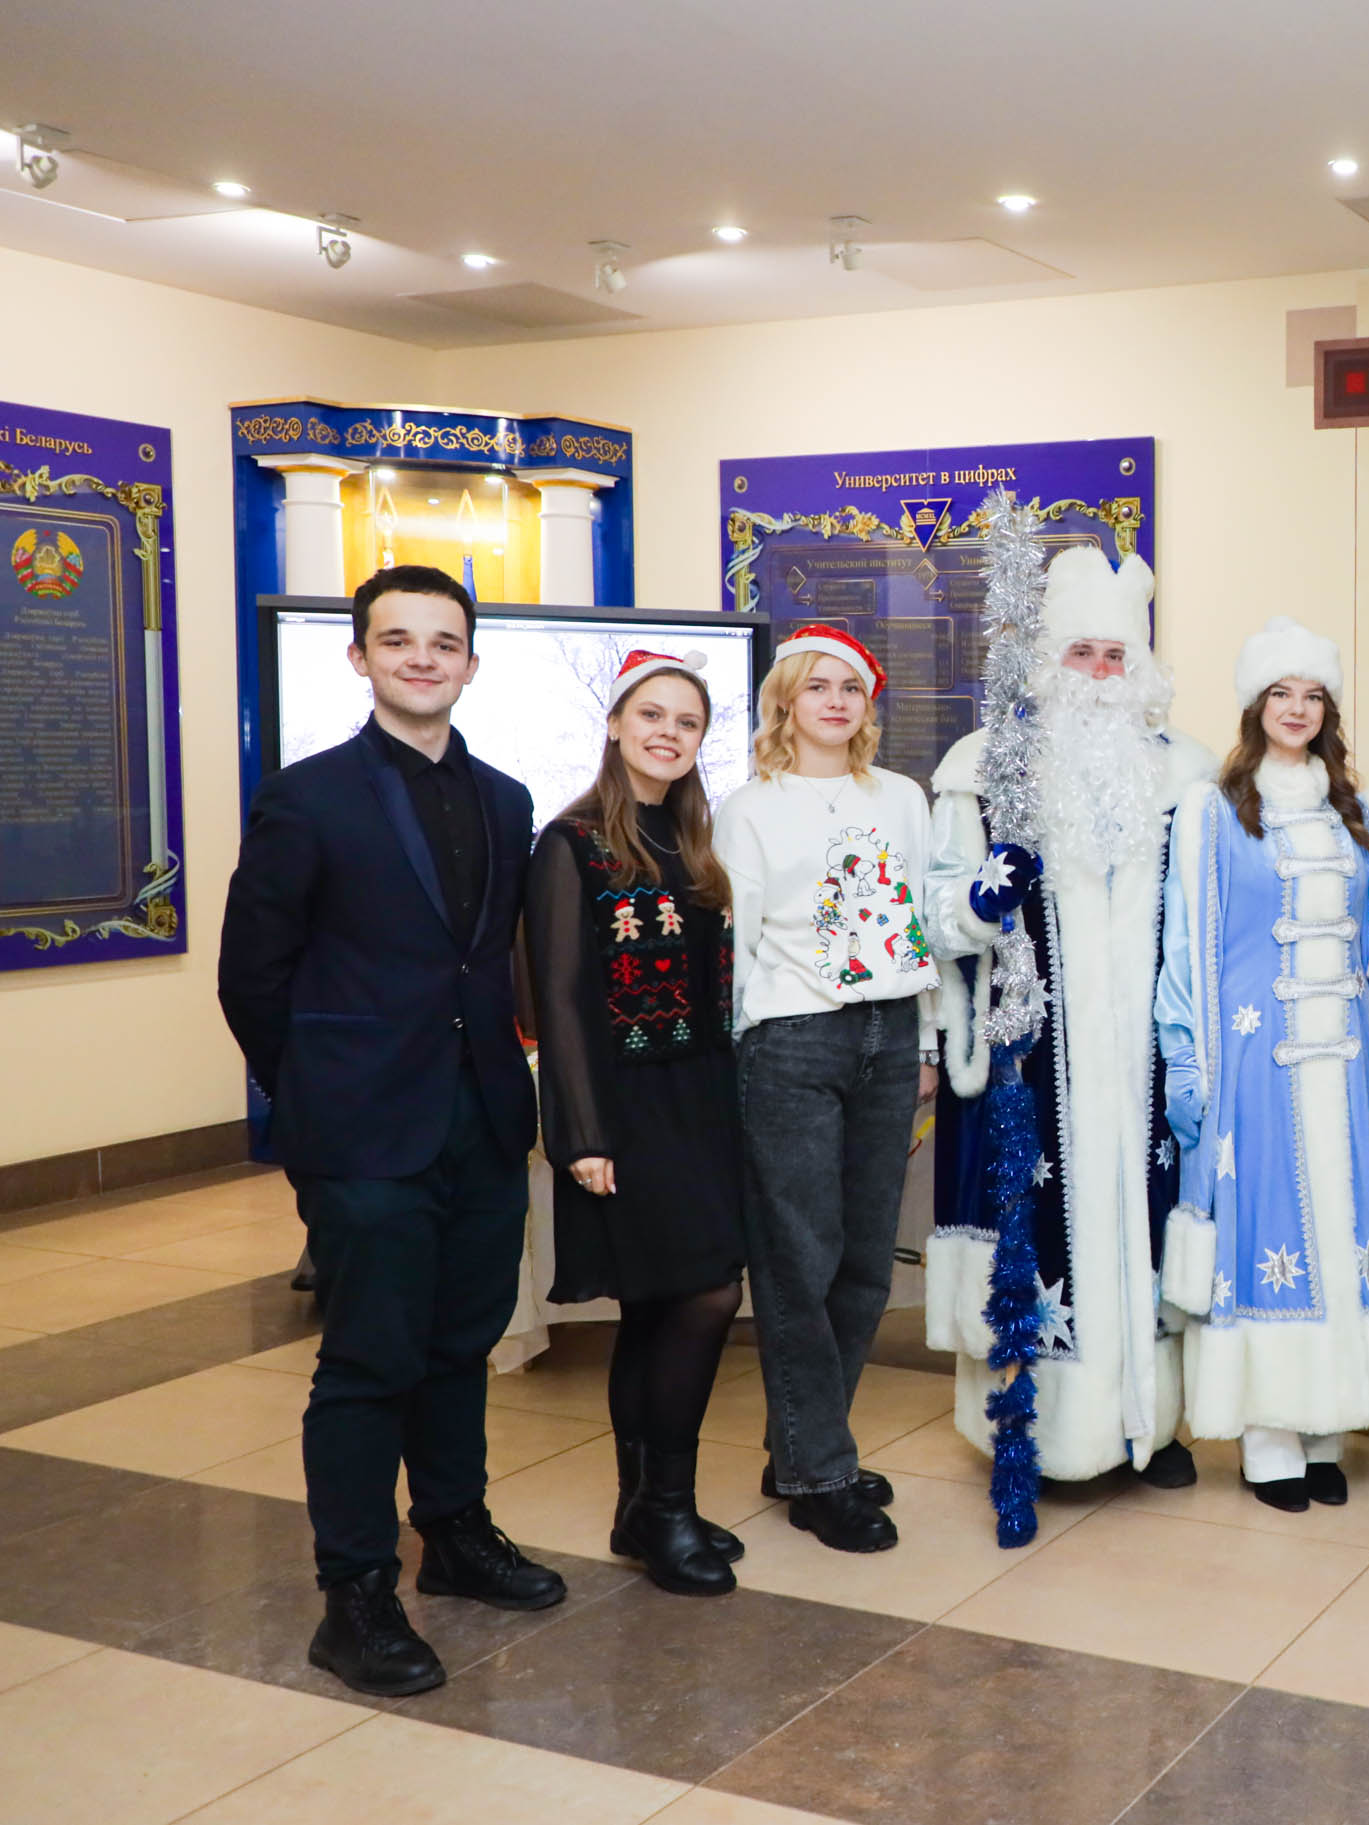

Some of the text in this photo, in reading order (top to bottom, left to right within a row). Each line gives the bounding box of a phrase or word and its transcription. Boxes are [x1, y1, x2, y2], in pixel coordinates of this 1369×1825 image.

[15, 427, 93, 456] Беларусь
[833, 464, 1017, 492] Университет в цифрах
